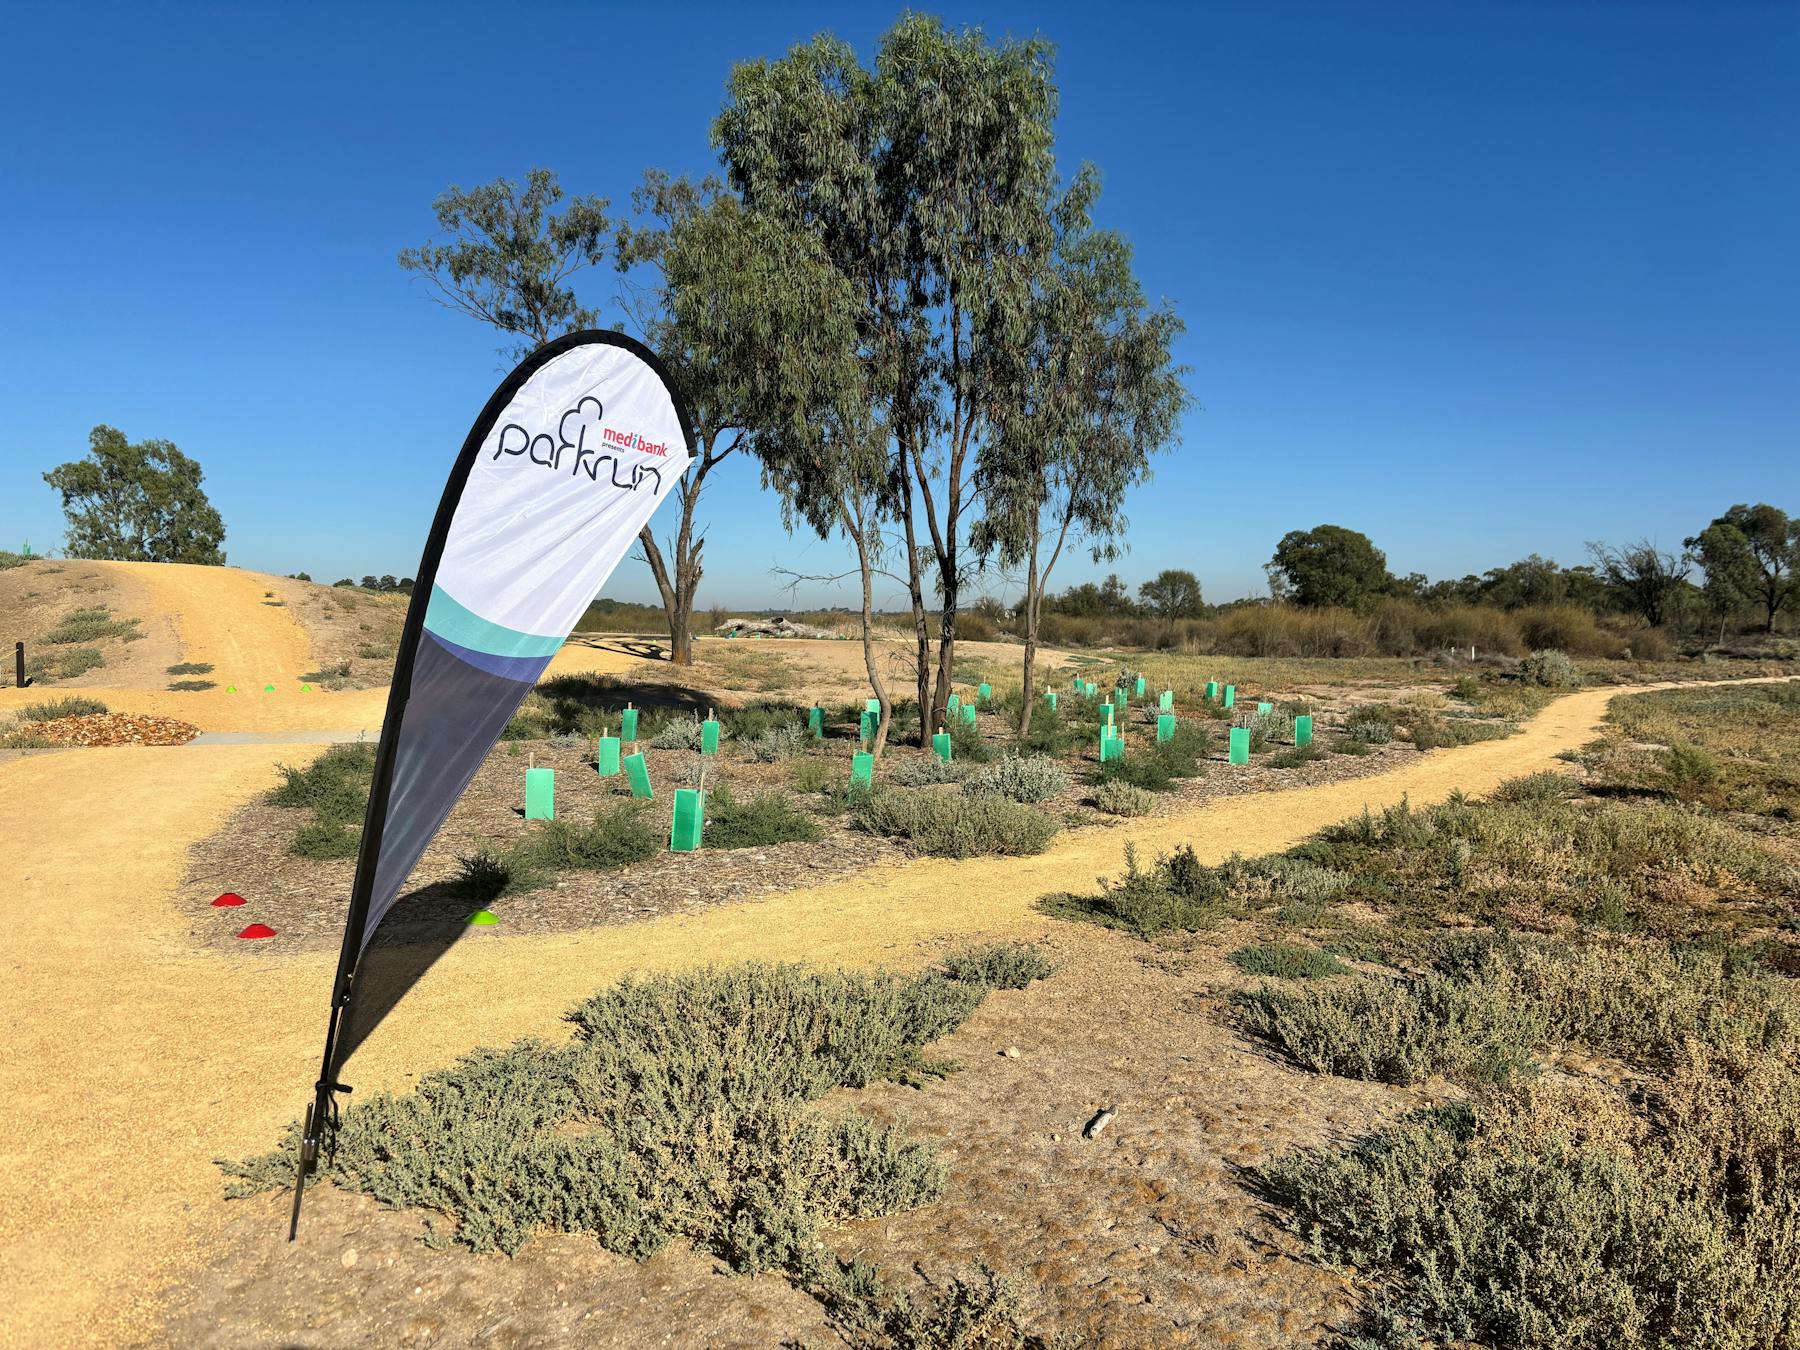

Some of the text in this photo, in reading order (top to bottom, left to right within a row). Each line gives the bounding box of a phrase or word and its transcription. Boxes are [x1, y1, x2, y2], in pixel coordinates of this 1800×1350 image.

[493, 396, 662, 495] parkrun
[601, 441, 625, 453] presents
[603, 427, 668, 457] medibank
